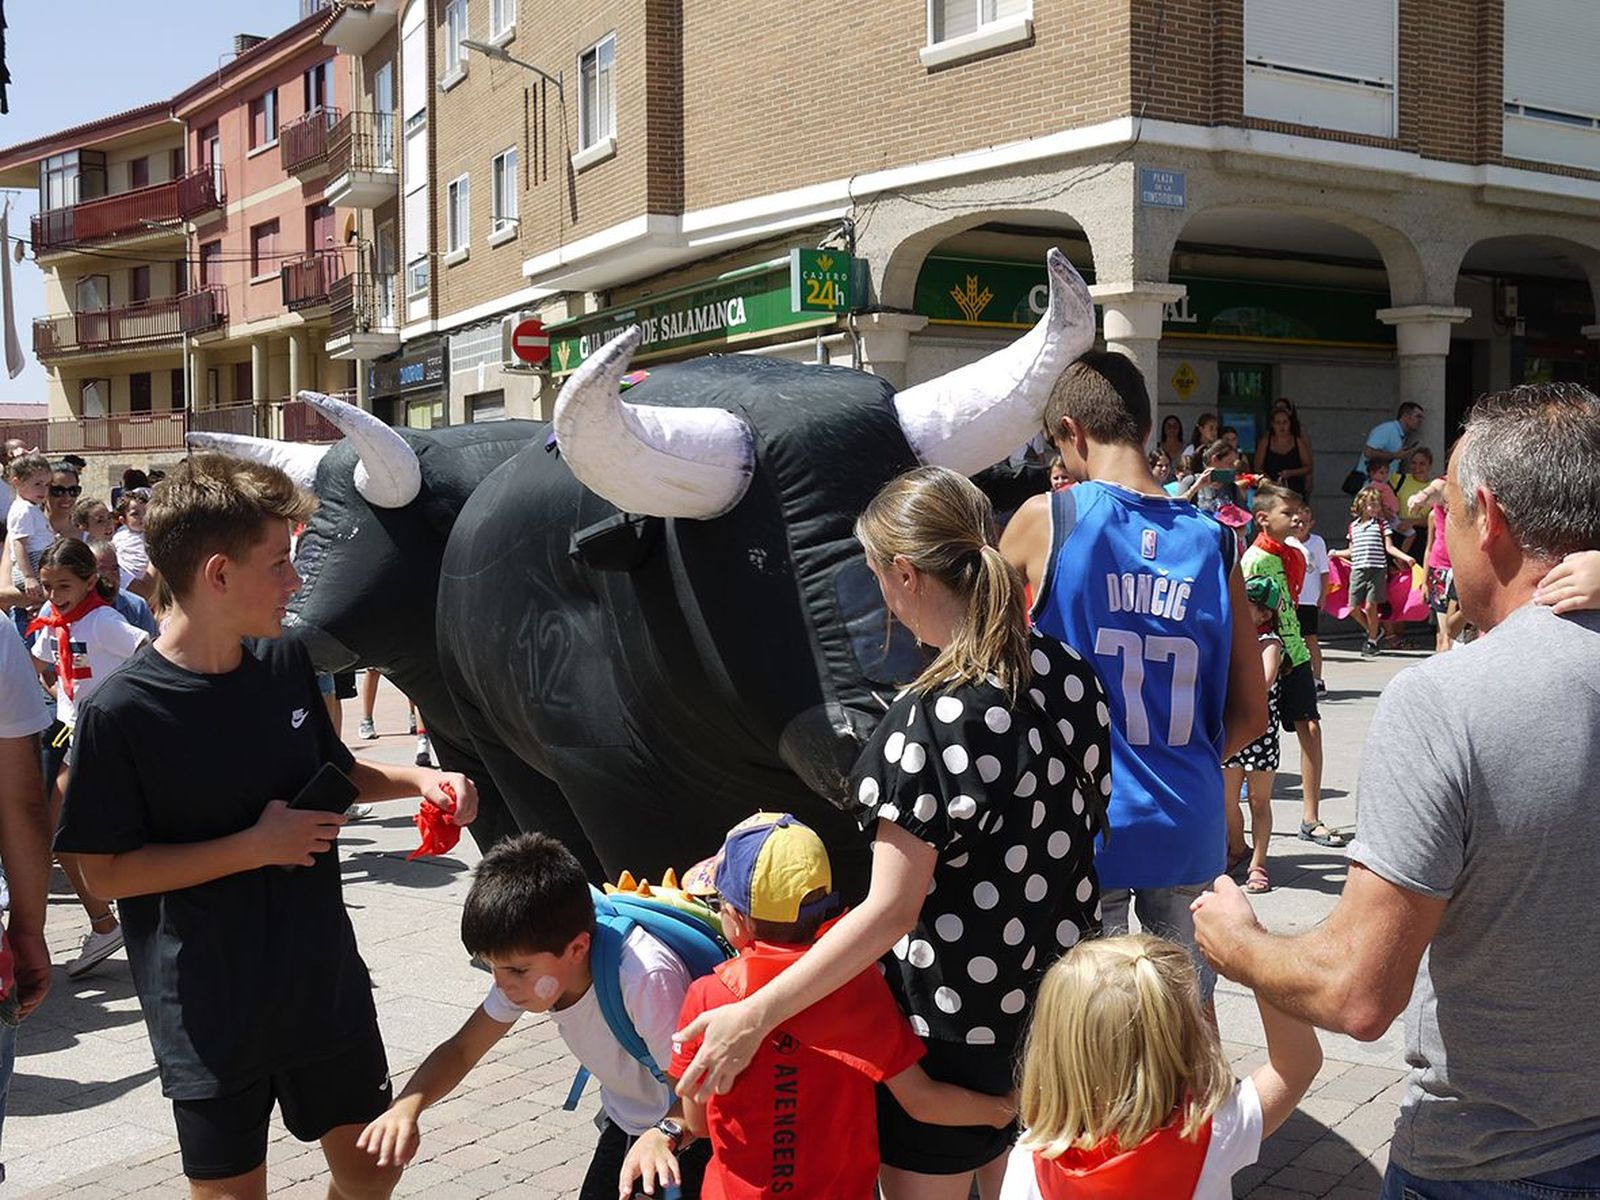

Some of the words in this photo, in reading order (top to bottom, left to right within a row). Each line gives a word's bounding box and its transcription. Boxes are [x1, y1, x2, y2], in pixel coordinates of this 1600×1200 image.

[802, 270, 848, 282] CAJERO
[807, 279, 845, 310] 24h
[641, 317, 659, 345] DE
[661, 297, 747, 340] SALAMANCA
[516, 600, 577, 709] 12
[1094, 627, 1199, 746] 77
[771, 1064, 799, 1194] AVENGERS
